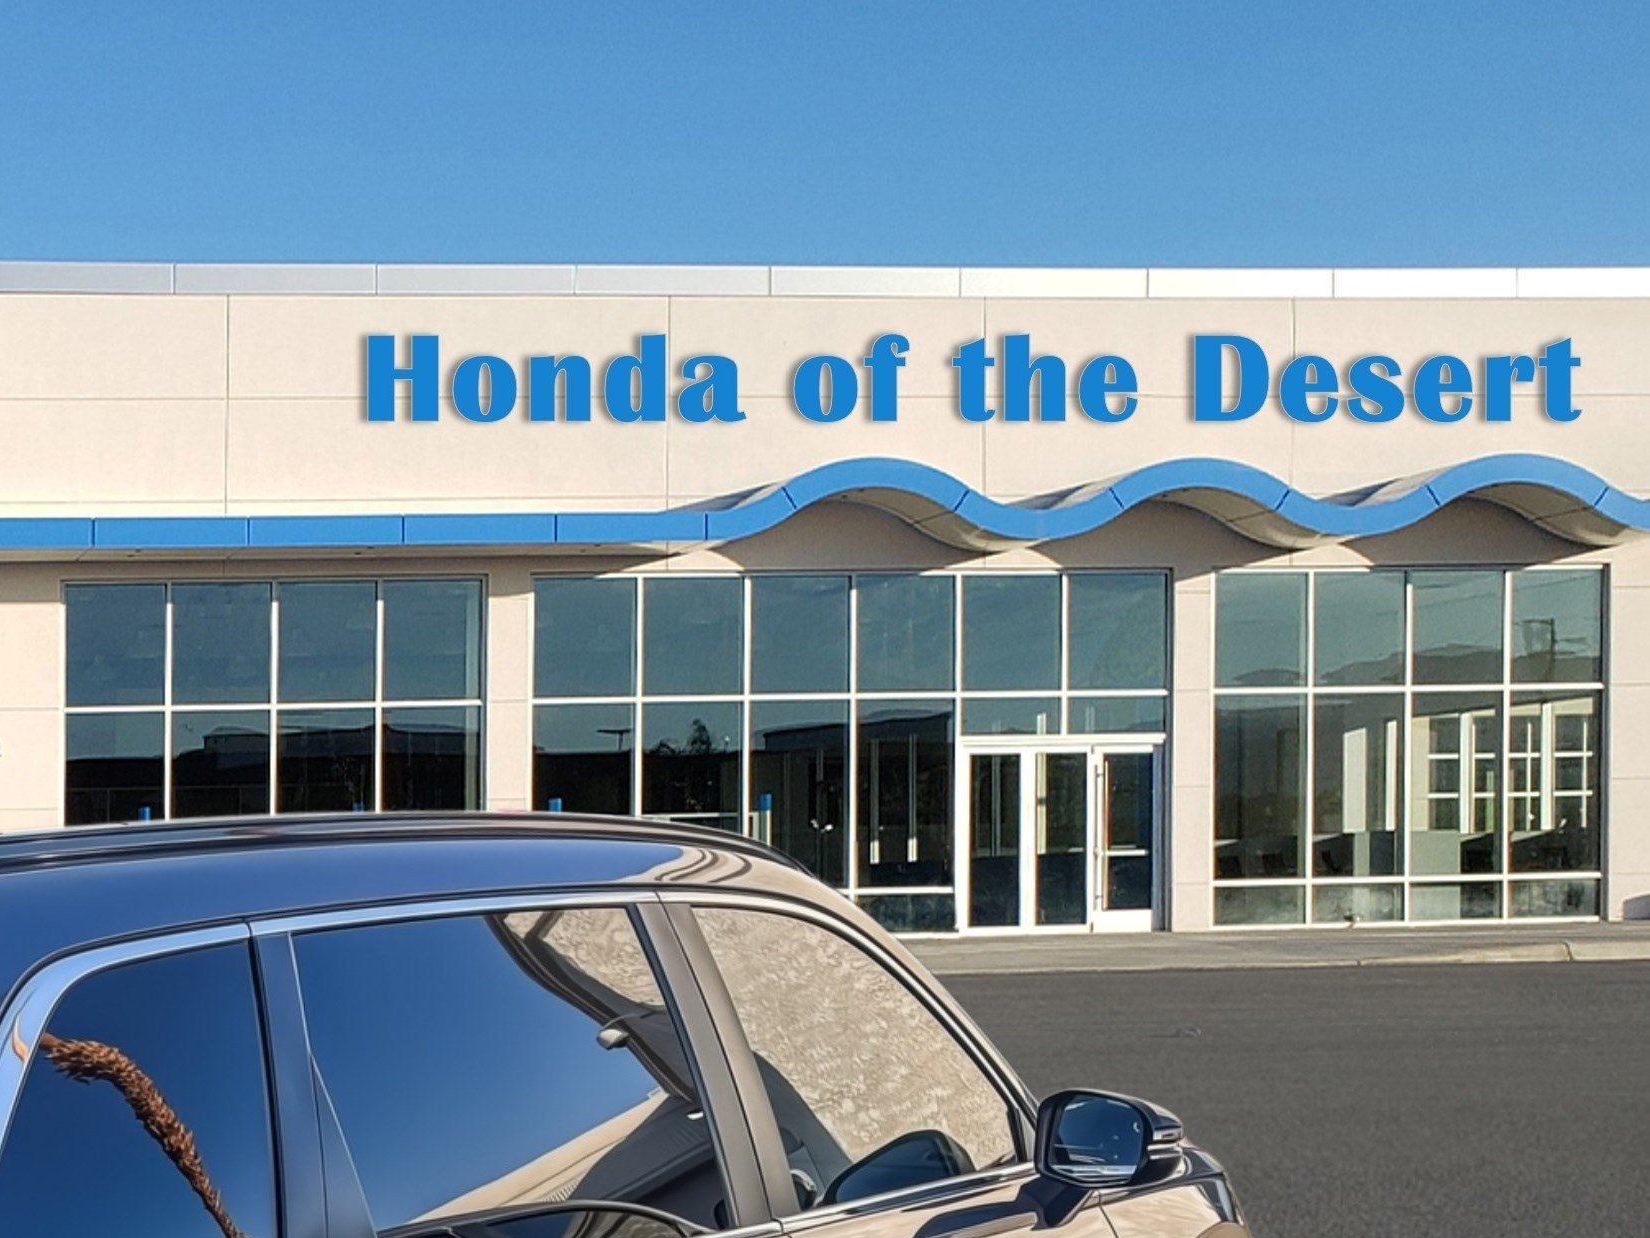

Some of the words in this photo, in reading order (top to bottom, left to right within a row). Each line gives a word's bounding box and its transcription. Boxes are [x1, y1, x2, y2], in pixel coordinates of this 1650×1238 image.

[365, 333, 747, 424] Honda
[793, 333, 911, 424] of
[951, 333, 1139, 424] the
[1193, 333, 1583, 424] Desert
